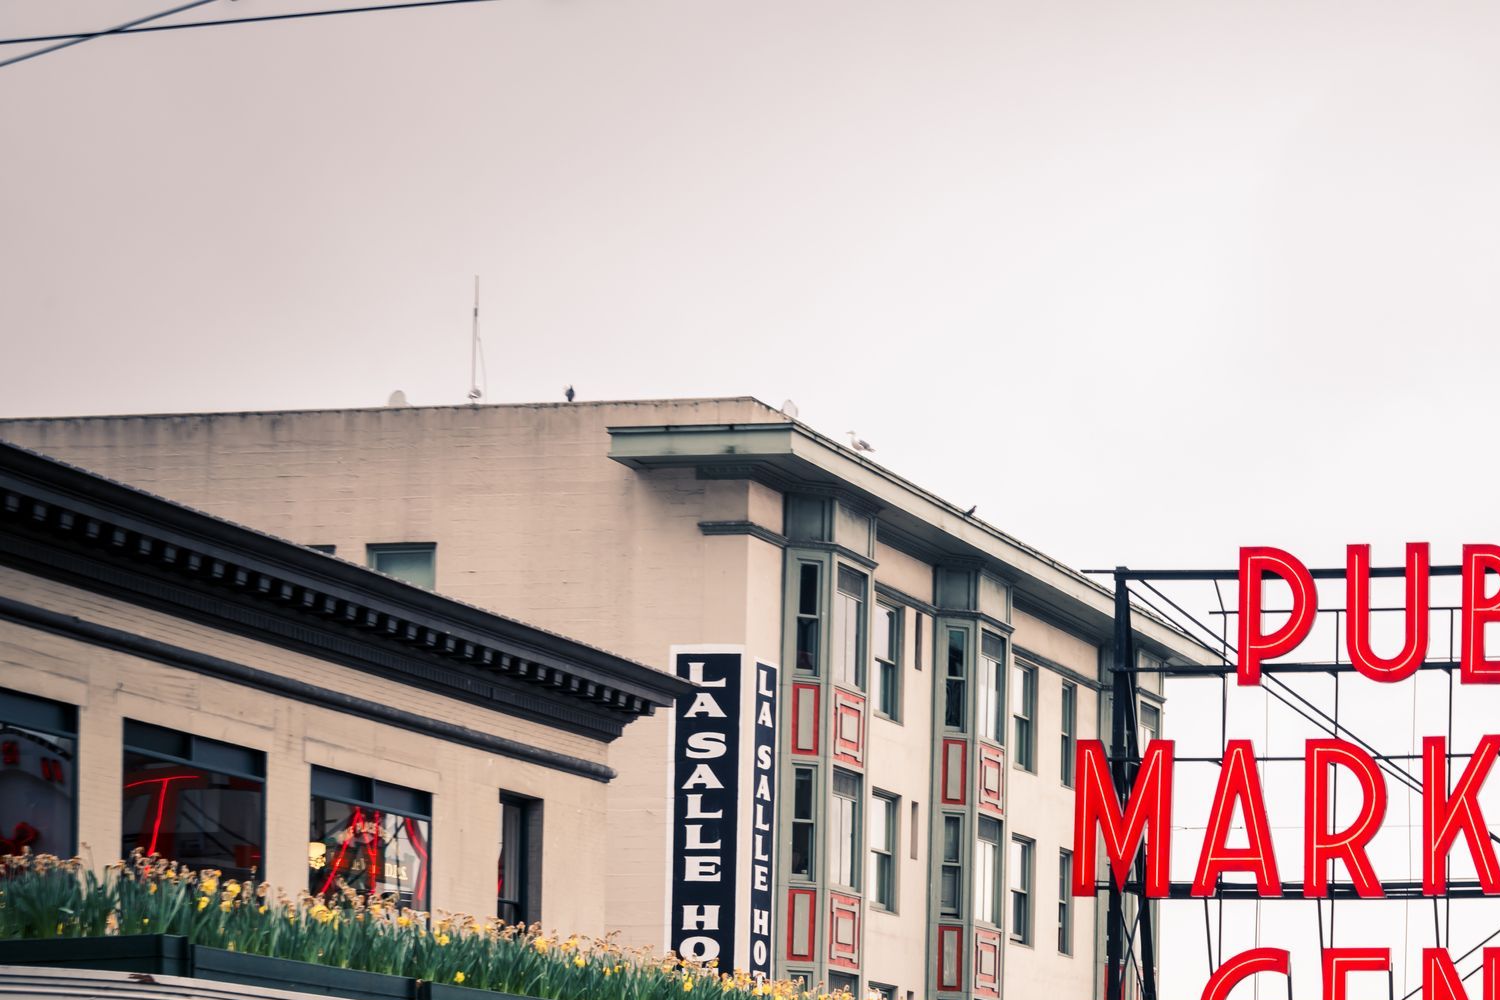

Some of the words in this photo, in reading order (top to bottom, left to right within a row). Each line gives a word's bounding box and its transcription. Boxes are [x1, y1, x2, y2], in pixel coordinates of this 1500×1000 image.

[681, 732, 727, 882] SALLE
[754, 744, 772, 892] SALLE
[679, 905, 722, 974] HO
